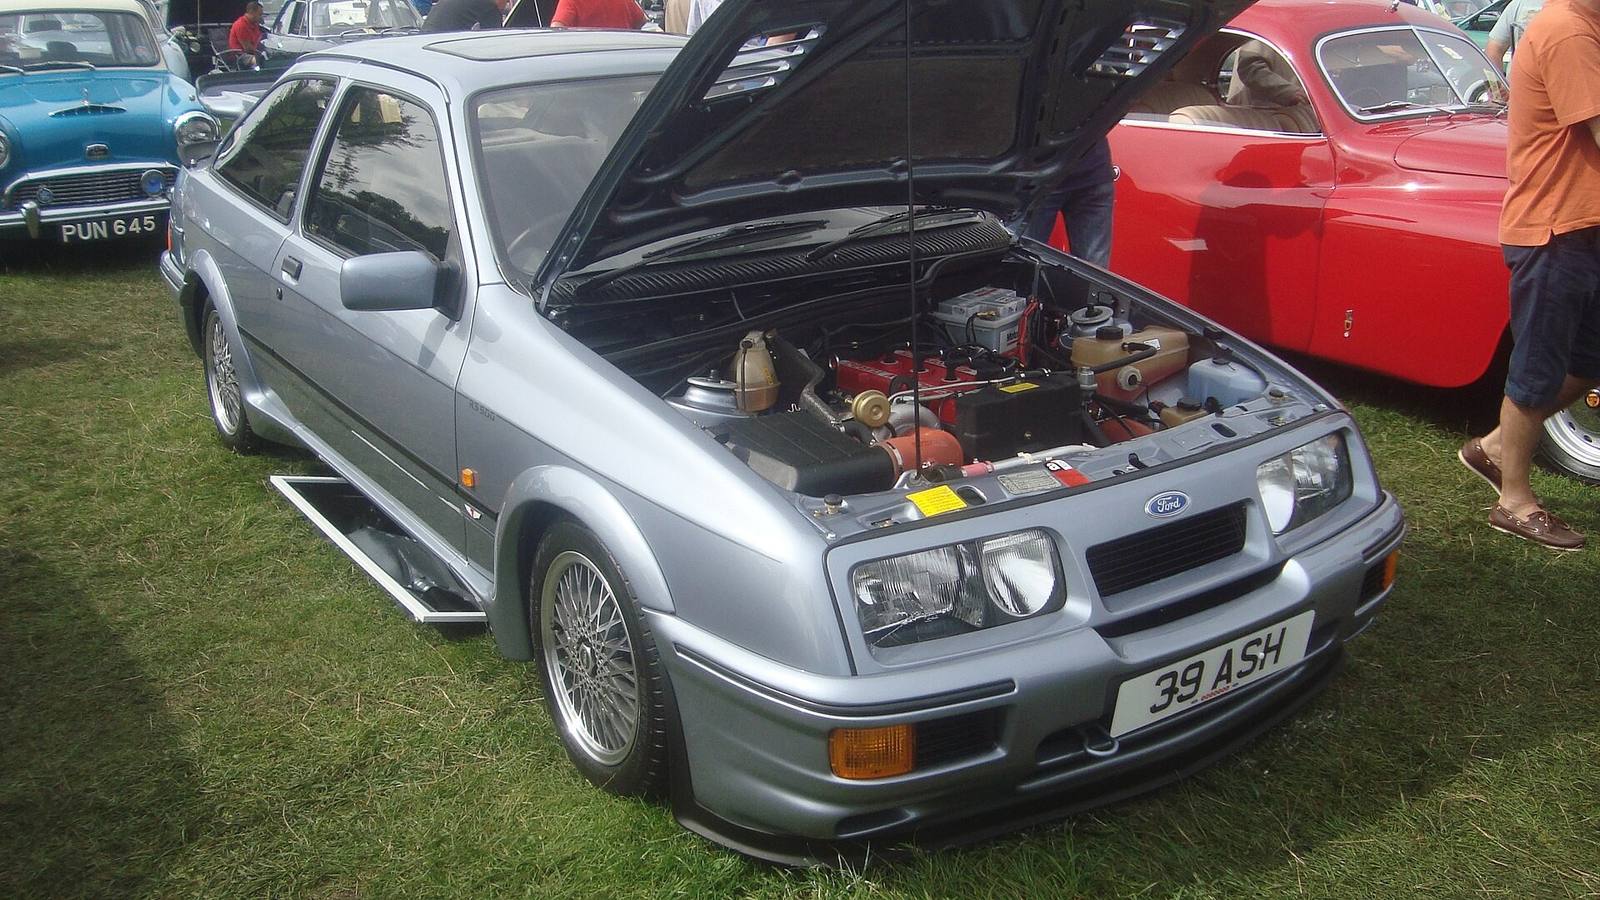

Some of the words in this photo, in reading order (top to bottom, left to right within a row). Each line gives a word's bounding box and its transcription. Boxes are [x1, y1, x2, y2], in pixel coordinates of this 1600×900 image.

[62, 221, 108, 242] PUN
[113, 216, 156, 236] 645
[1157, 496, 1182, 512] Ford
[1150, 660, 1206, 714] 39
[1211, 627, 1287, 691] ASH
